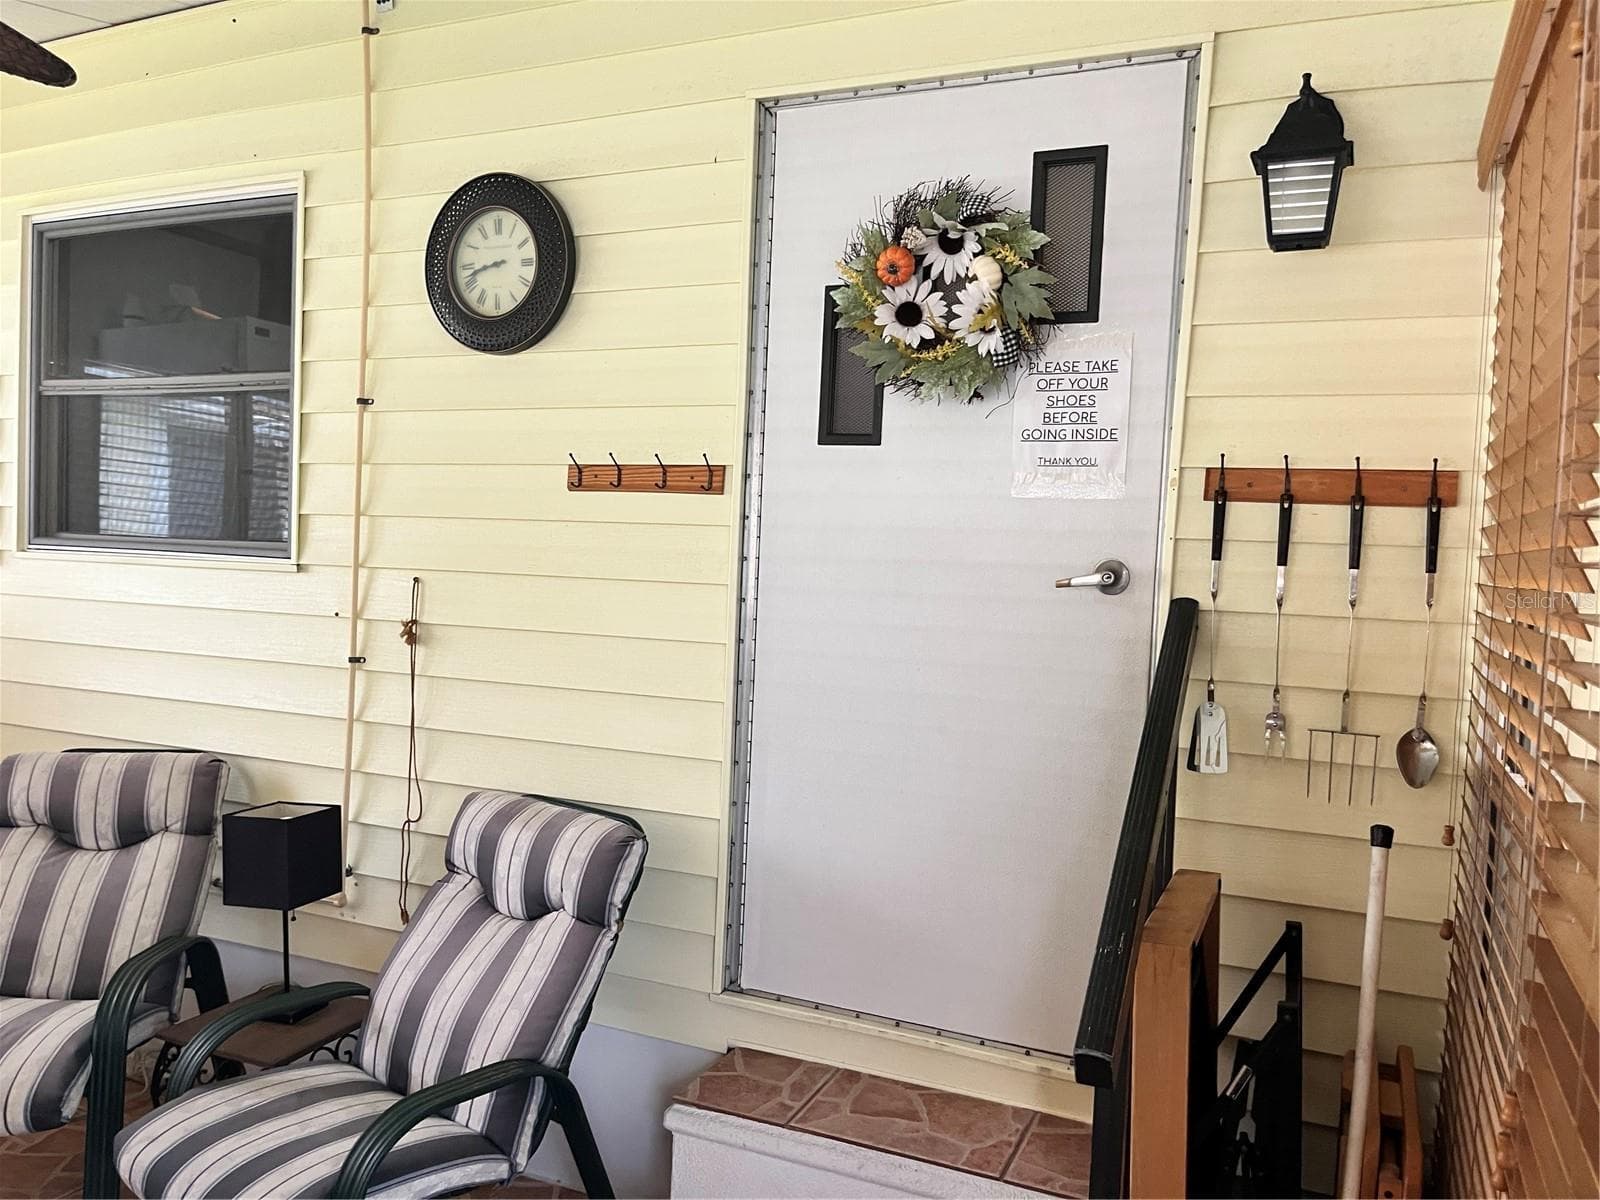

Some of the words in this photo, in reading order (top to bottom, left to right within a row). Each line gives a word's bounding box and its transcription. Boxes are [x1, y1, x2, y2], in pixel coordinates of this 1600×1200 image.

[1029, 361, 1080, 373] PLEASE
[1085, 360, 1119, 372] TAKE
[1036, 378, 1065, 390] OFF
[1068, 377, 1109, 389] YOUR
[1046, 394, 1097, 407] SHOES
[1042, 411, 1098, 424] BEFORE
[1021, 428, 1067, 441] GOING
[1071, 428, 1119, 440] INSIDE
[1038, 456, 1072, 465] THANK
